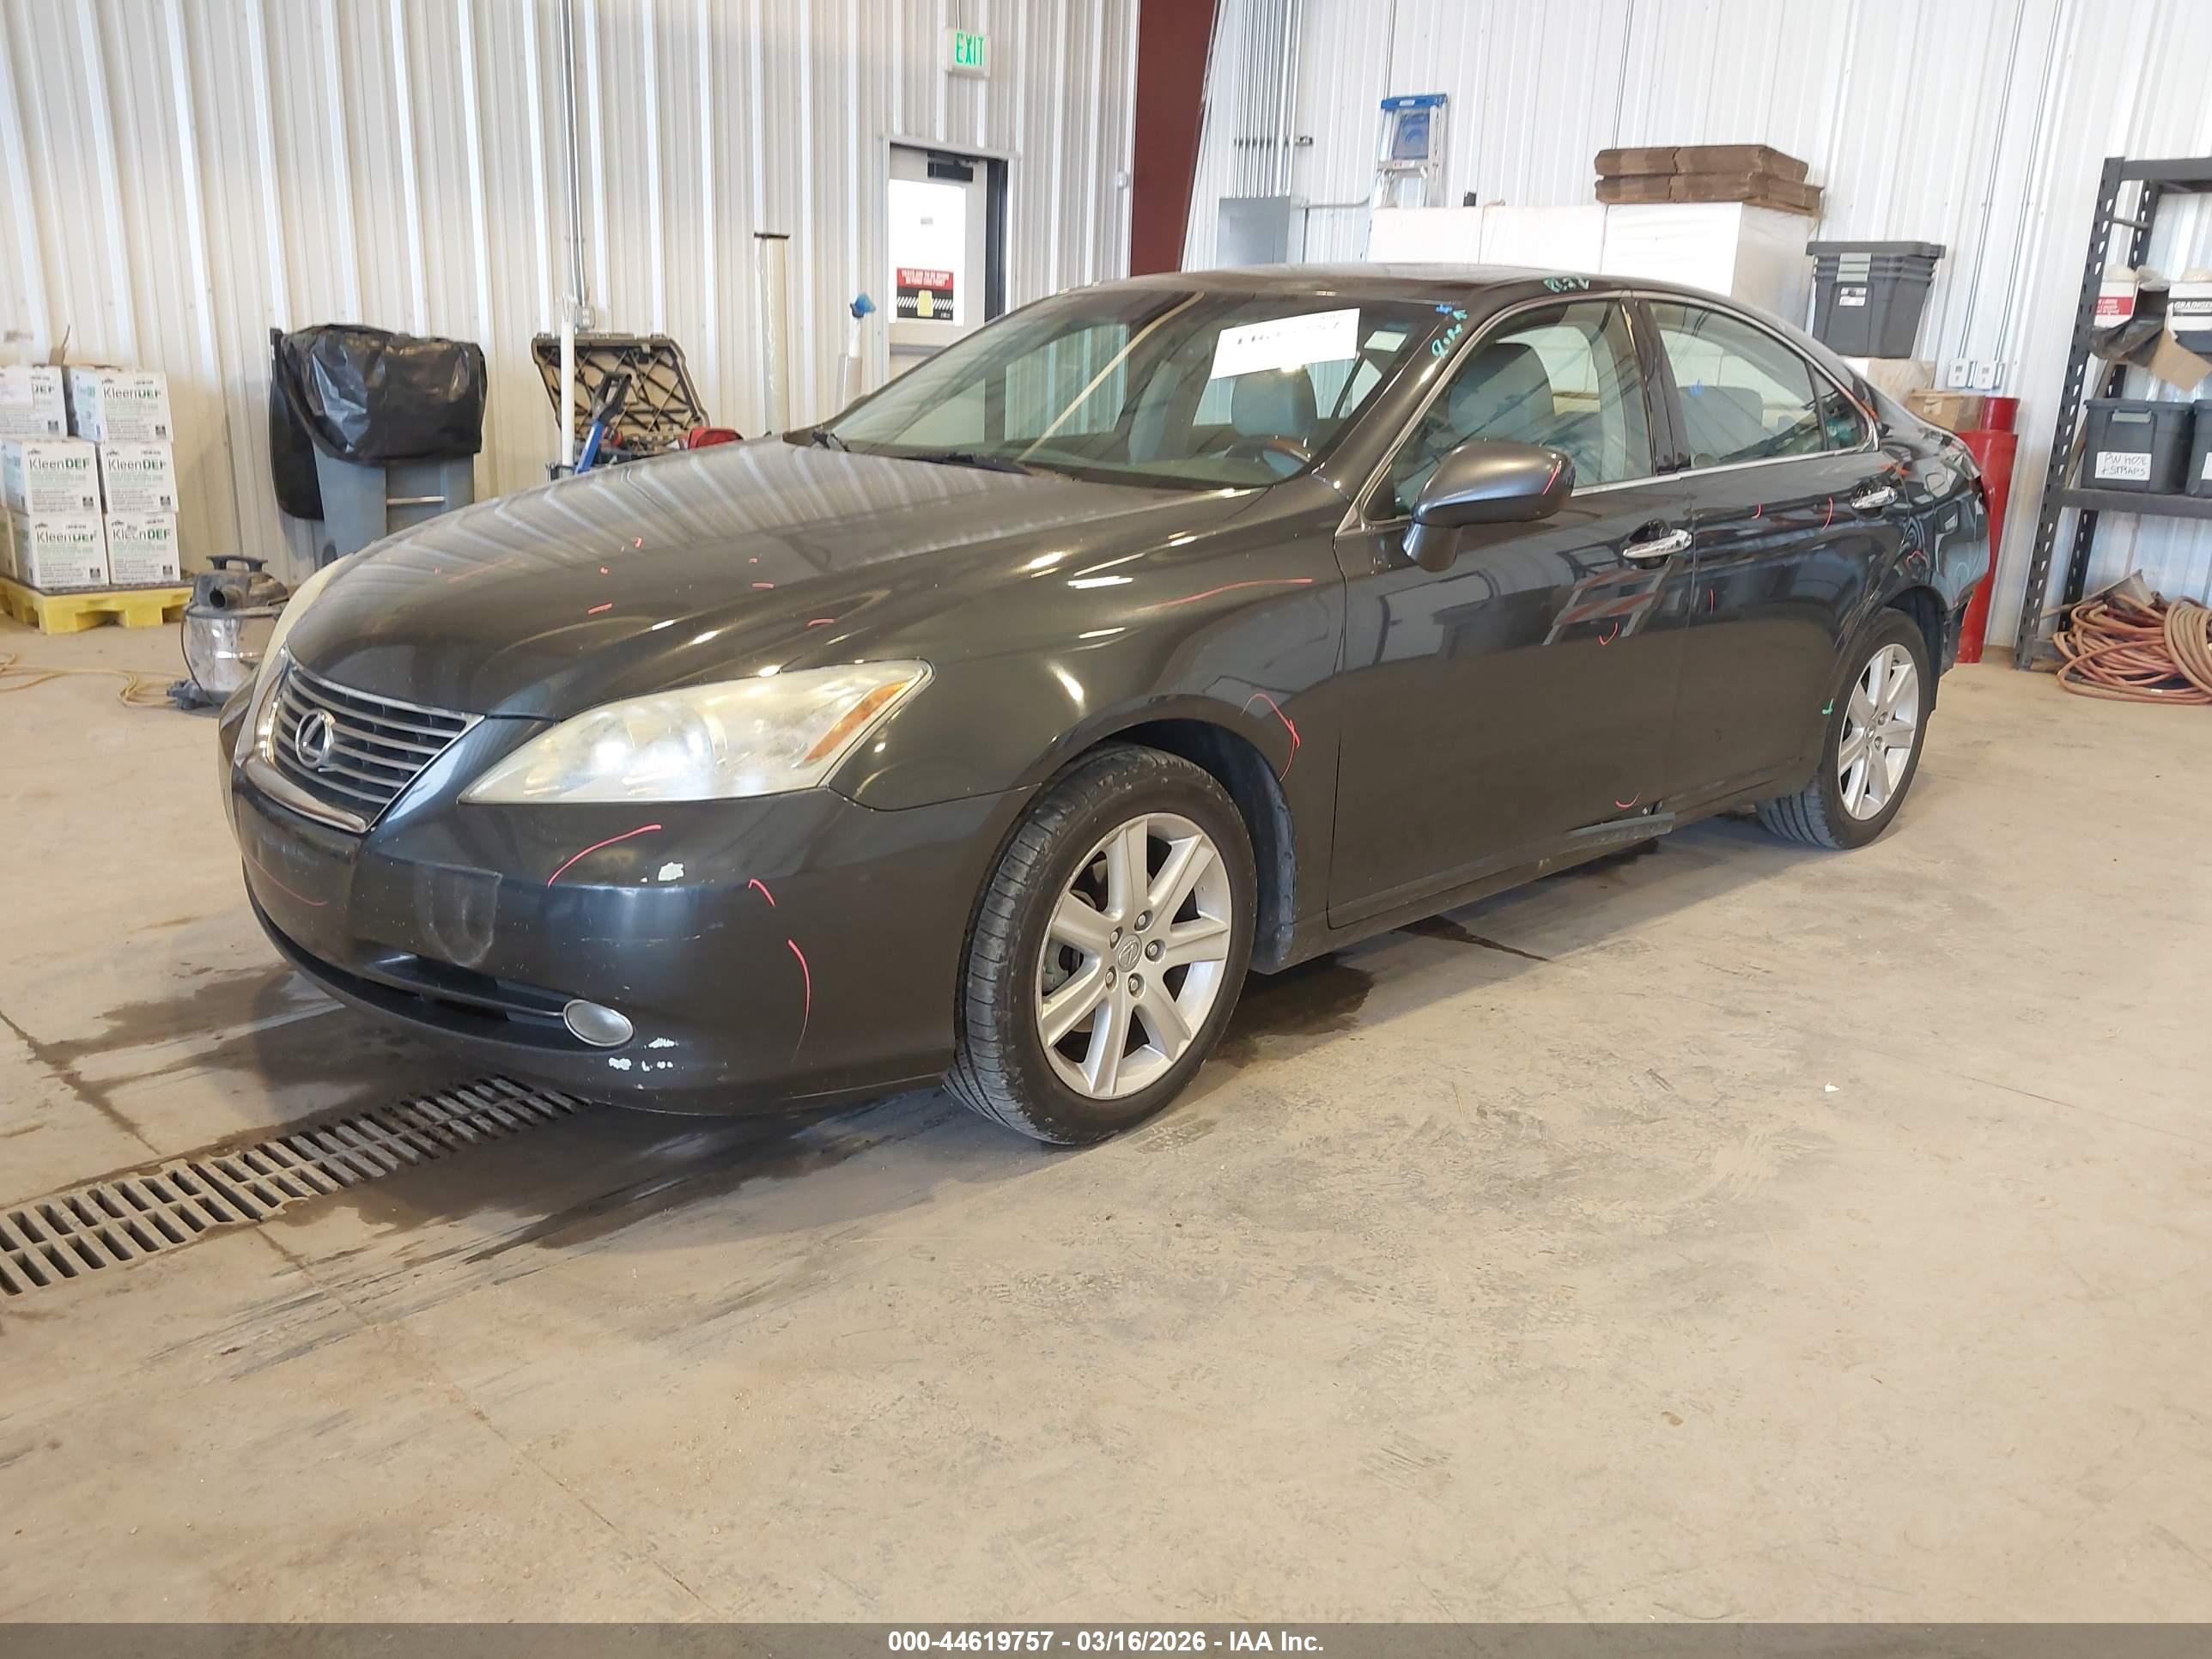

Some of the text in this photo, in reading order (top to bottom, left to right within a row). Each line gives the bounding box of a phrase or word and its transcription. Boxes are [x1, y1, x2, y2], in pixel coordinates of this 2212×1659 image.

[956, 33, 985, 67] EXIT
[103, 386, 161, 399] KleenDEF
[29, 457, 90, 471] KleenDEF
[108, 458, 167, 471] KleenDEF
[36, 529, 97, 544] KleenDEF
